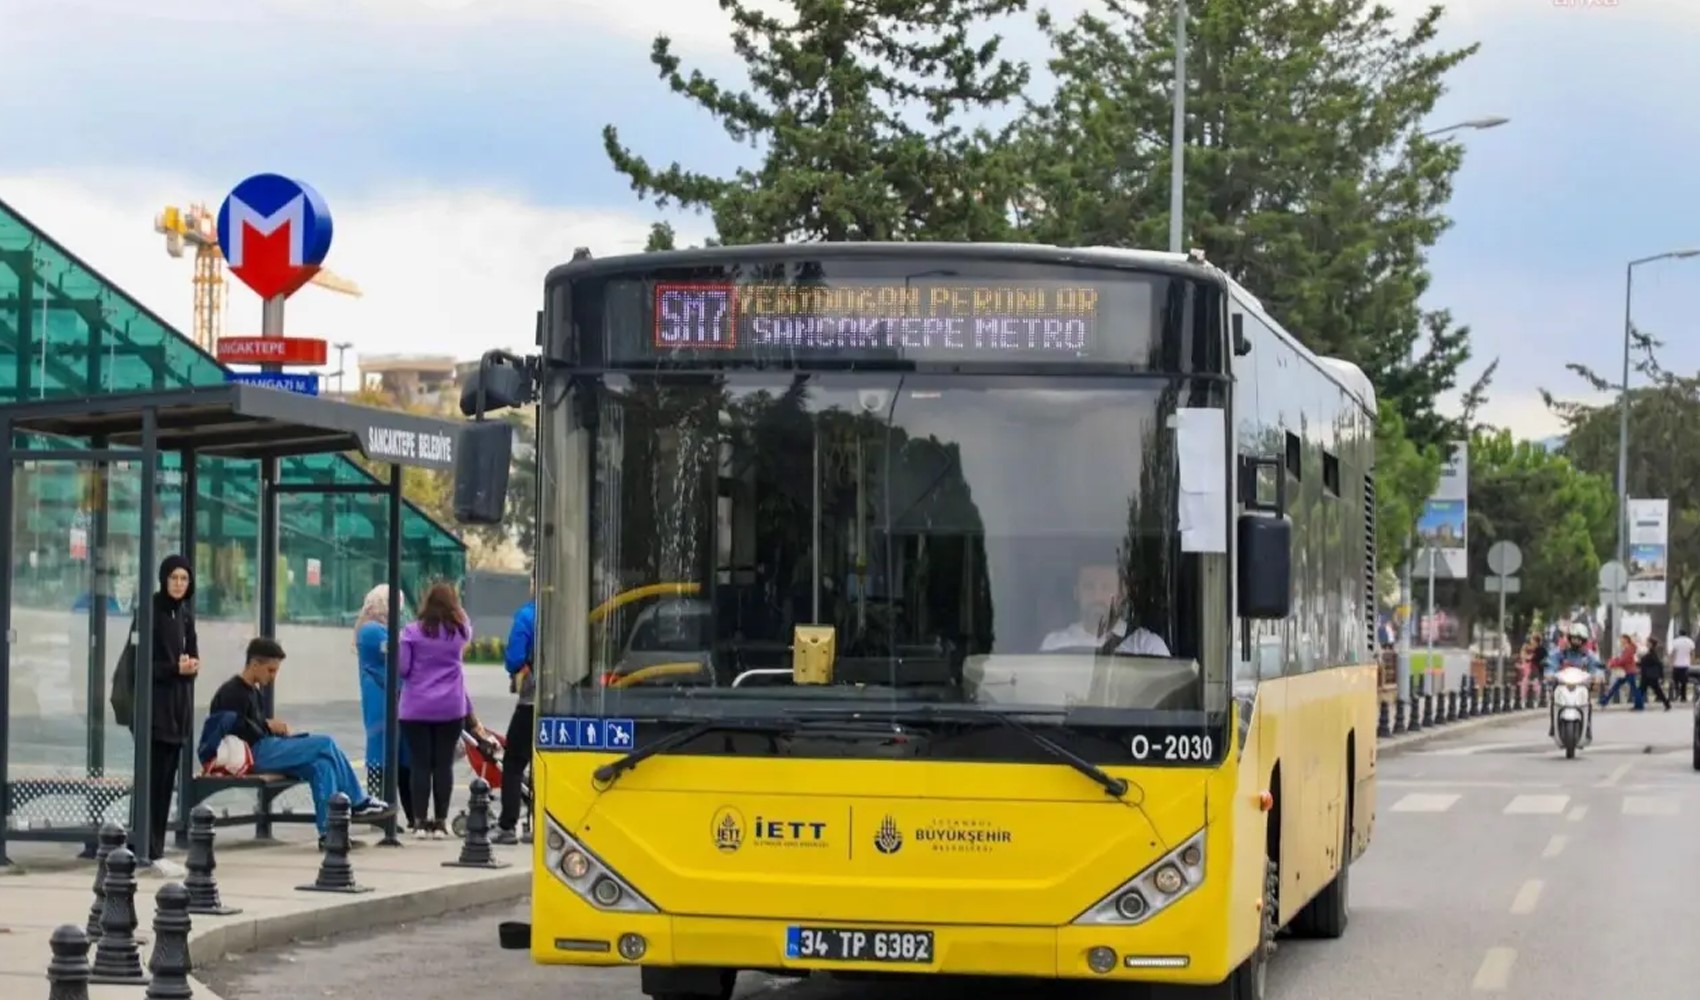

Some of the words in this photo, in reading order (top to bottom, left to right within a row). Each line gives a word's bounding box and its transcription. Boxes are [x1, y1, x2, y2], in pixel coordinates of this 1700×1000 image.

[229, 193, 304, 267] M
[662, 290, 727, 342] SM7
[752, 317, 964, 348] SANCAKTEPE
[975, 317, 1086, 348] METRO
[220, 341, 286, 355] ANCAKTEPE
[368, 426, 415, 458] SANCAKTEPE
[418, 430, 452, 462] BELEDİYE
[1131, 734, 1213, 759] O-2030
[755, 816, 827, 839] İETT
[801, 930, 829, 956] 34
[839, 931, 866, 958] TP
[874, 932, 929, 959] 6382
